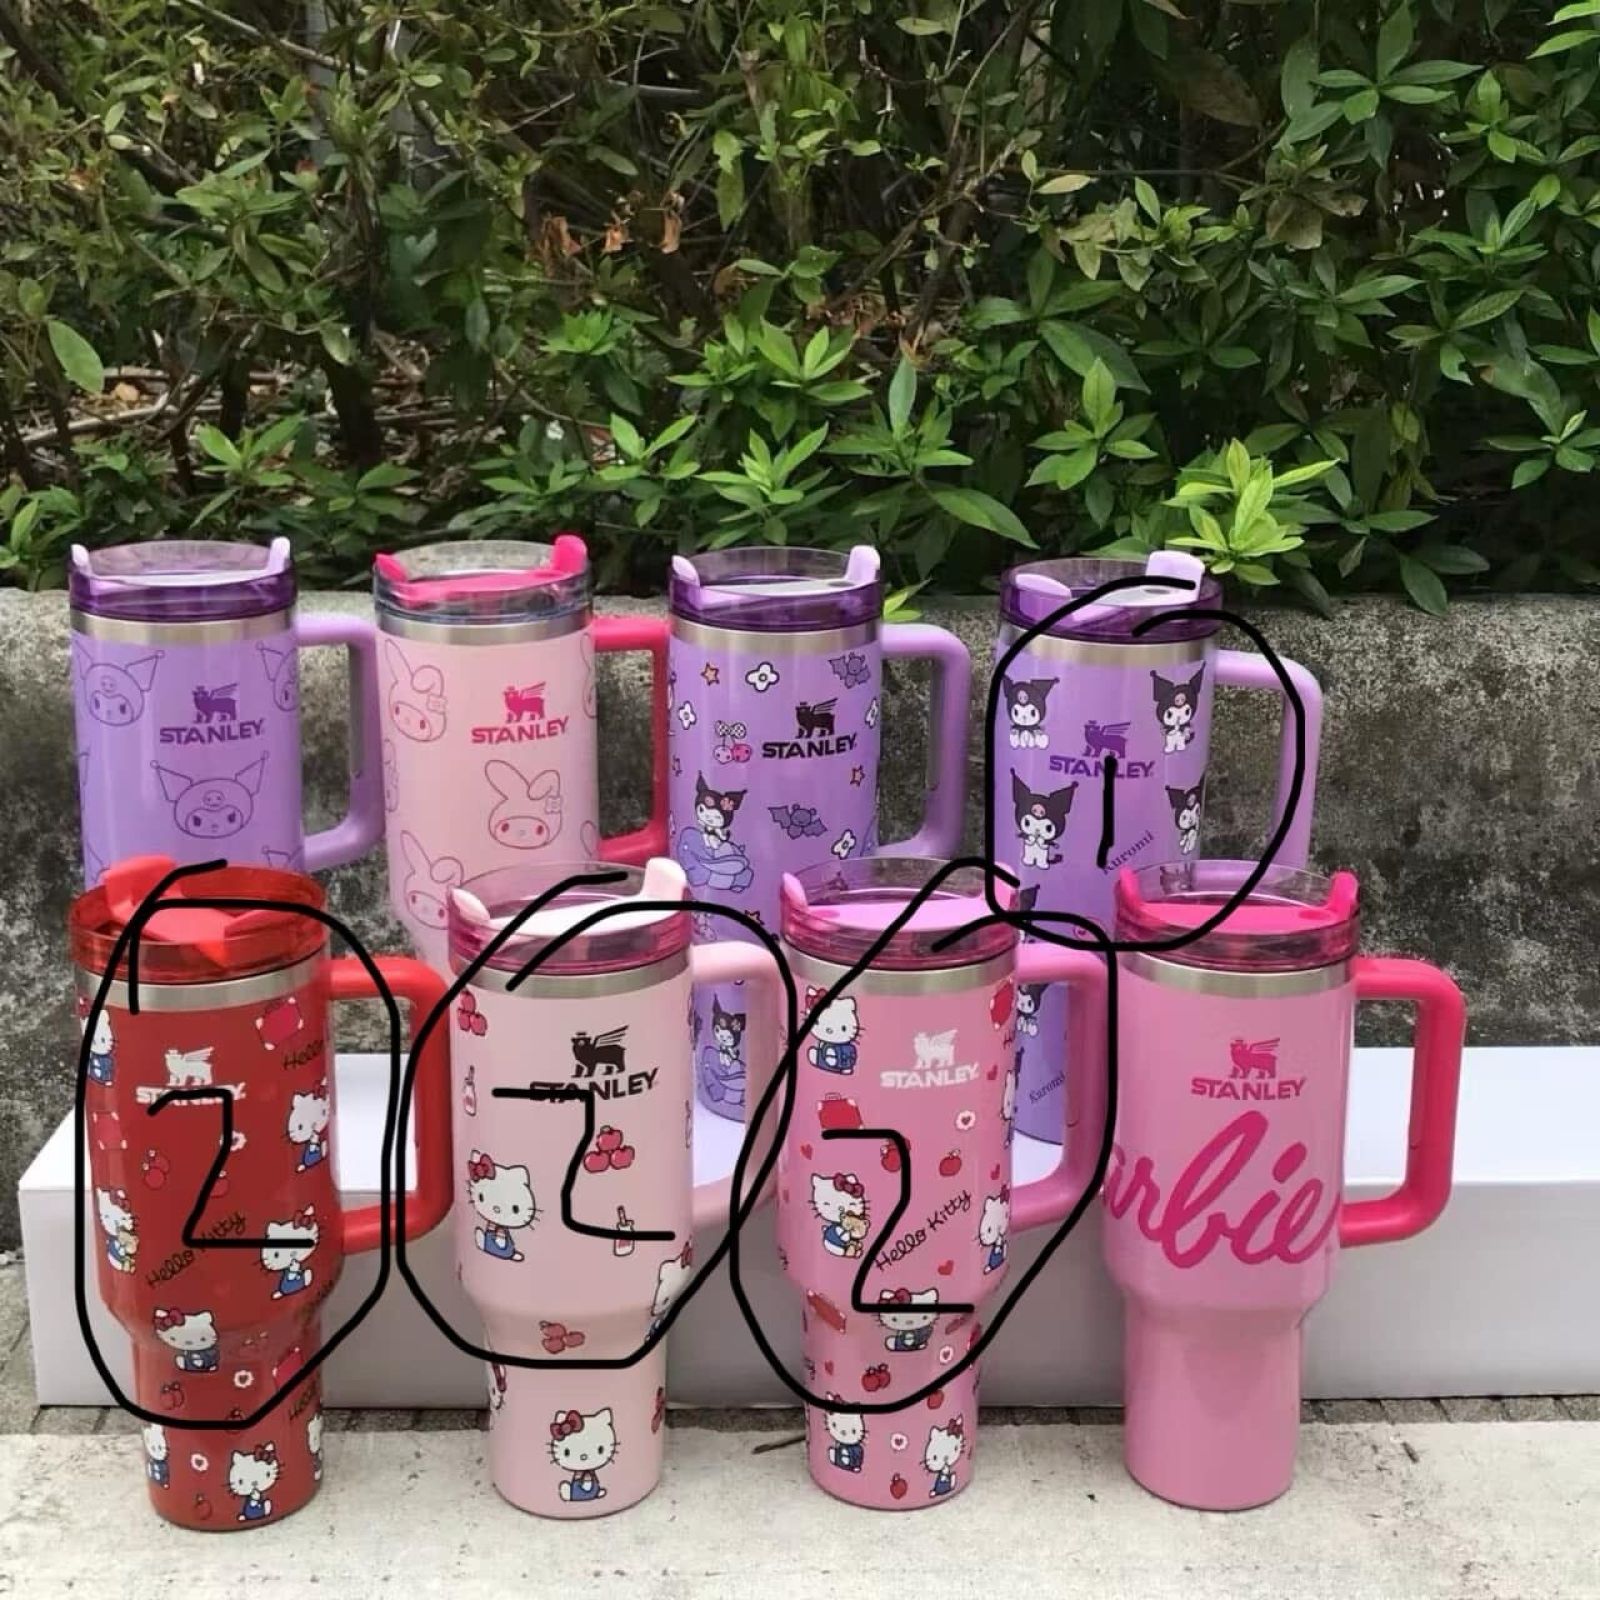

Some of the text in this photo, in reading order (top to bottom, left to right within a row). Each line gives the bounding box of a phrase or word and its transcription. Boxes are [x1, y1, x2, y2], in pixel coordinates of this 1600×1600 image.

[159, 717, 264, 745] STANLEY
[471, 715, 569, 744] STANLEY
[762, 732, 857, 759] STANLEY
[1049, 755, 1155, 779] STANEY
[880, 1061, 979, 1089] STANLEY
[1191, 1077, 1305, 1100] STANLEY
[875, 1189, 971, 1272] Hello Kitty
[145, 1249, 195, 1290] Hello
